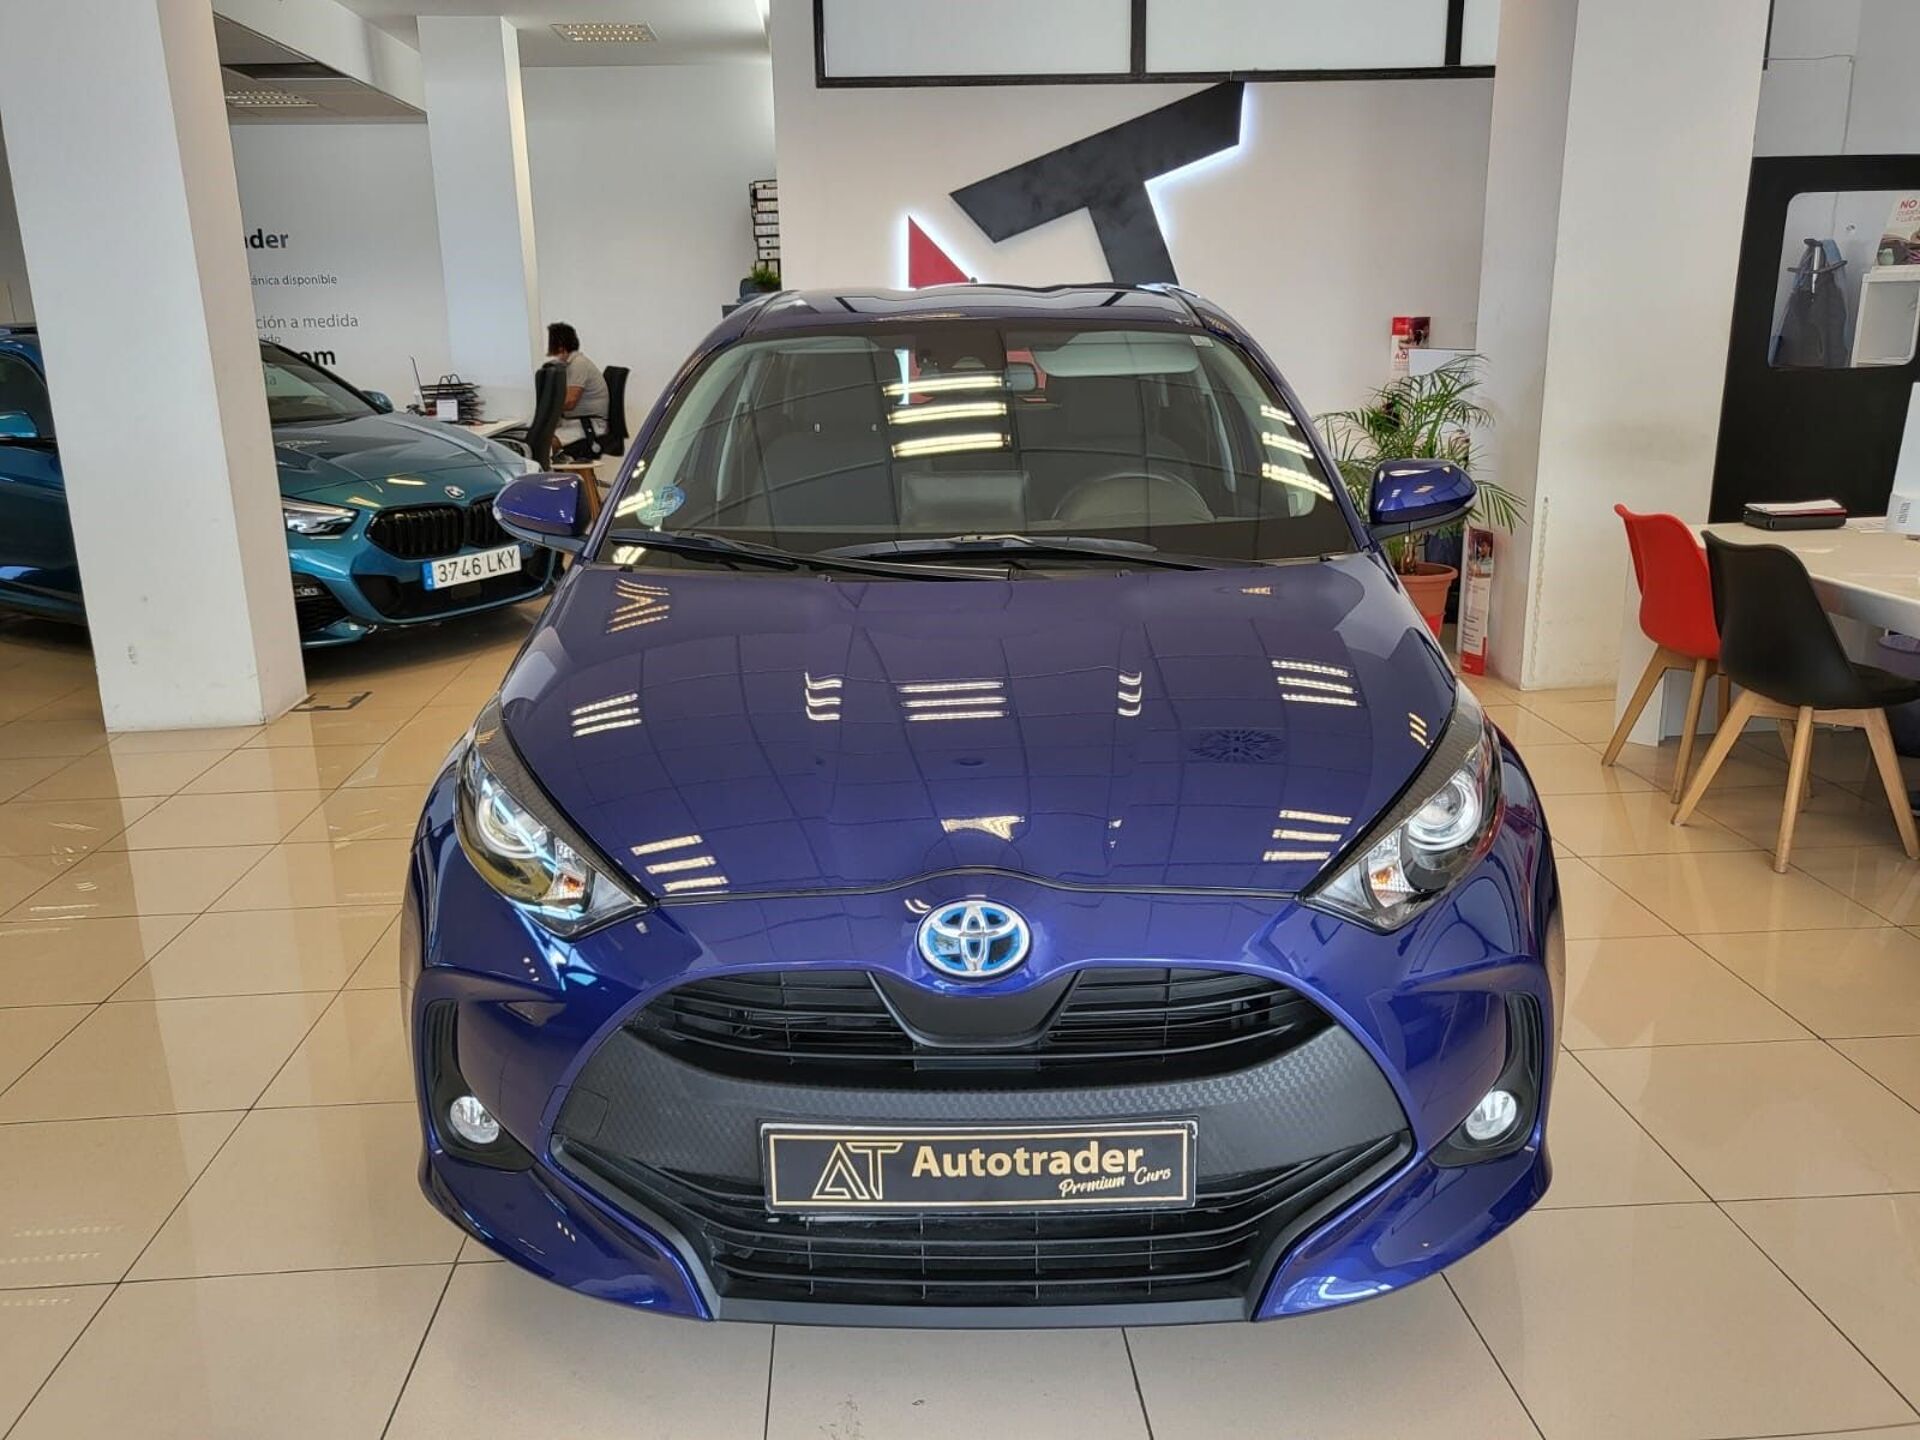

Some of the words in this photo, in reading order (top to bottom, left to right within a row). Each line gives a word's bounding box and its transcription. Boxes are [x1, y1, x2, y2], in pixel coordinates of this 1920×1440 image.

[282, 273, 338, 288] disponible
[290, 317, 299, 329] a
[302, 313, 359, 329] medida
[437, 557, 482, 583] 3746
[487, 549, 517, 573] LKY
[911, 1140, 1144, 1178] Autotrader
[1058, 1175, 1125, 1198] Premium
[1133, 1166, 1171, 1186] Cars
